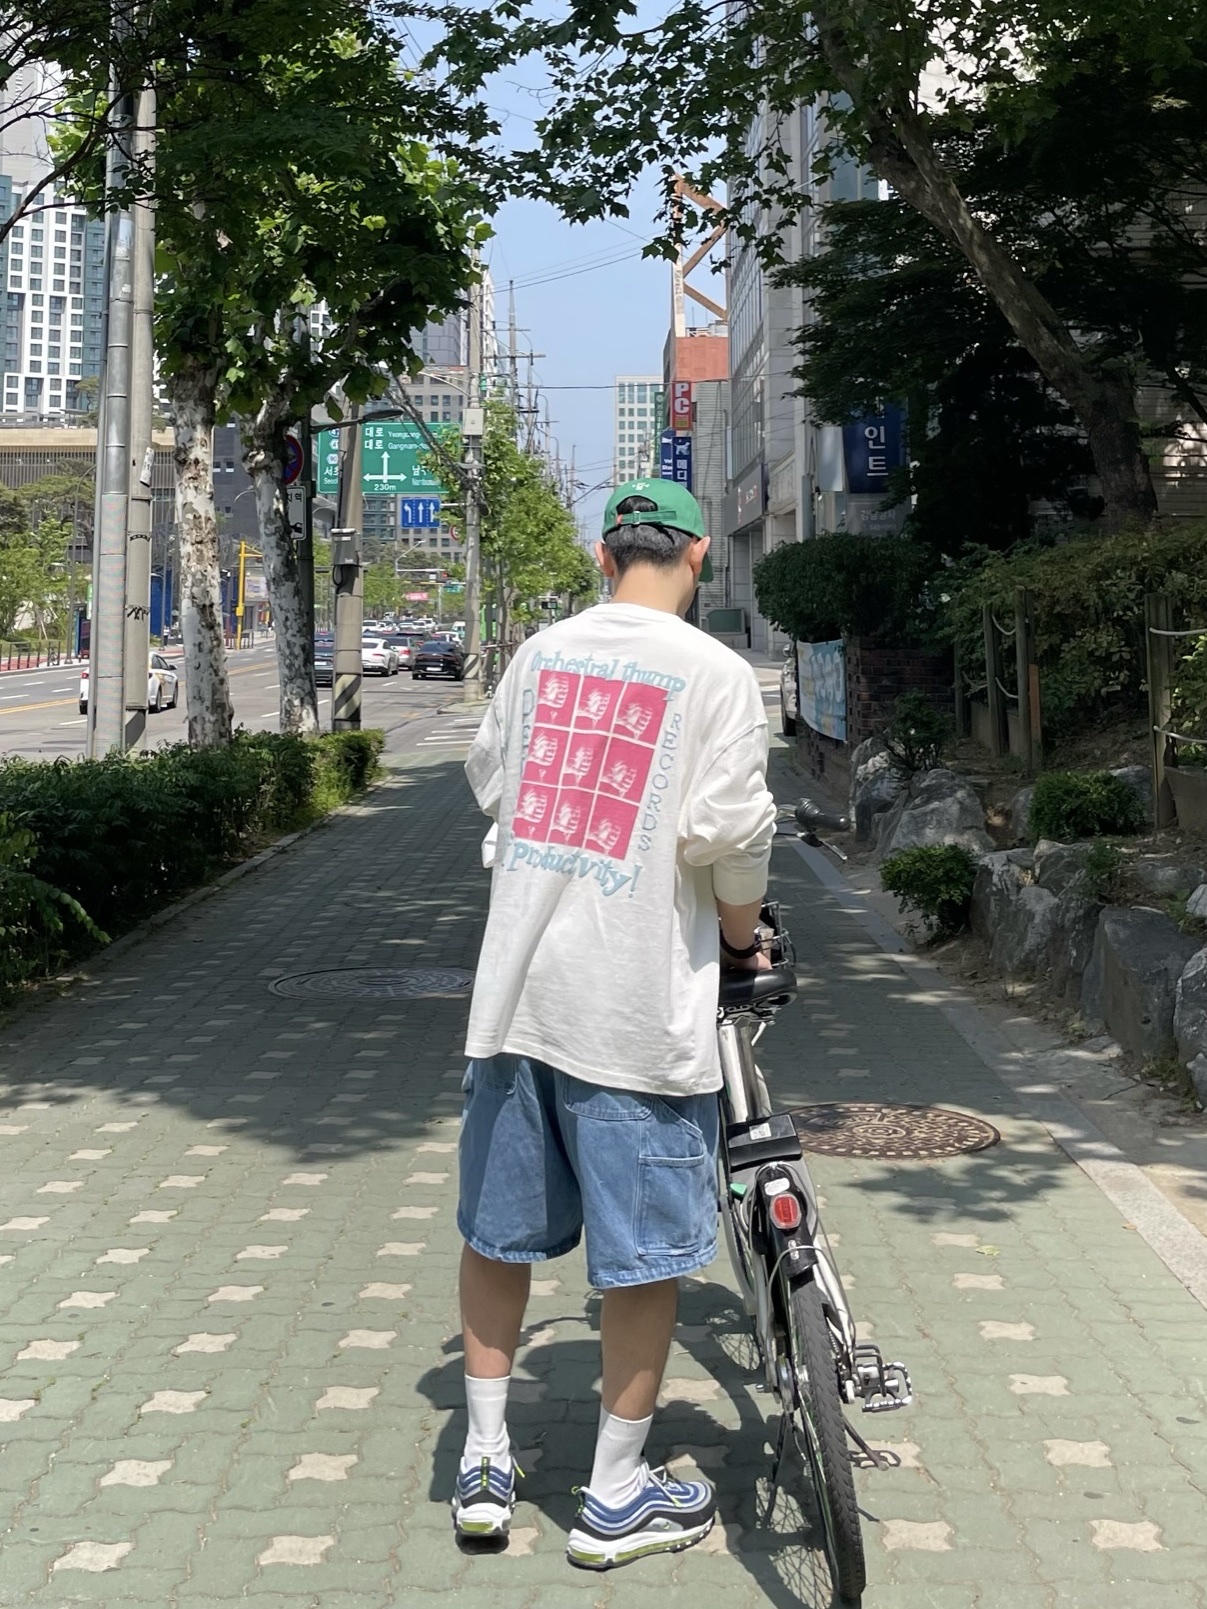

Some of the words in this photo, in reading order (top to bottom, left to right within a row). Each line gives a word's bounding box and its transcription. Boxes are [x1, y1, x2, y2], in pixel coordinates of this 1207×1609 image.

[674, 382, 690, 414] PC
[864, 404, 889, 477] 인트
[622, 660, 686, 702] thump
[638, 713, 682, 852] RECORDS
